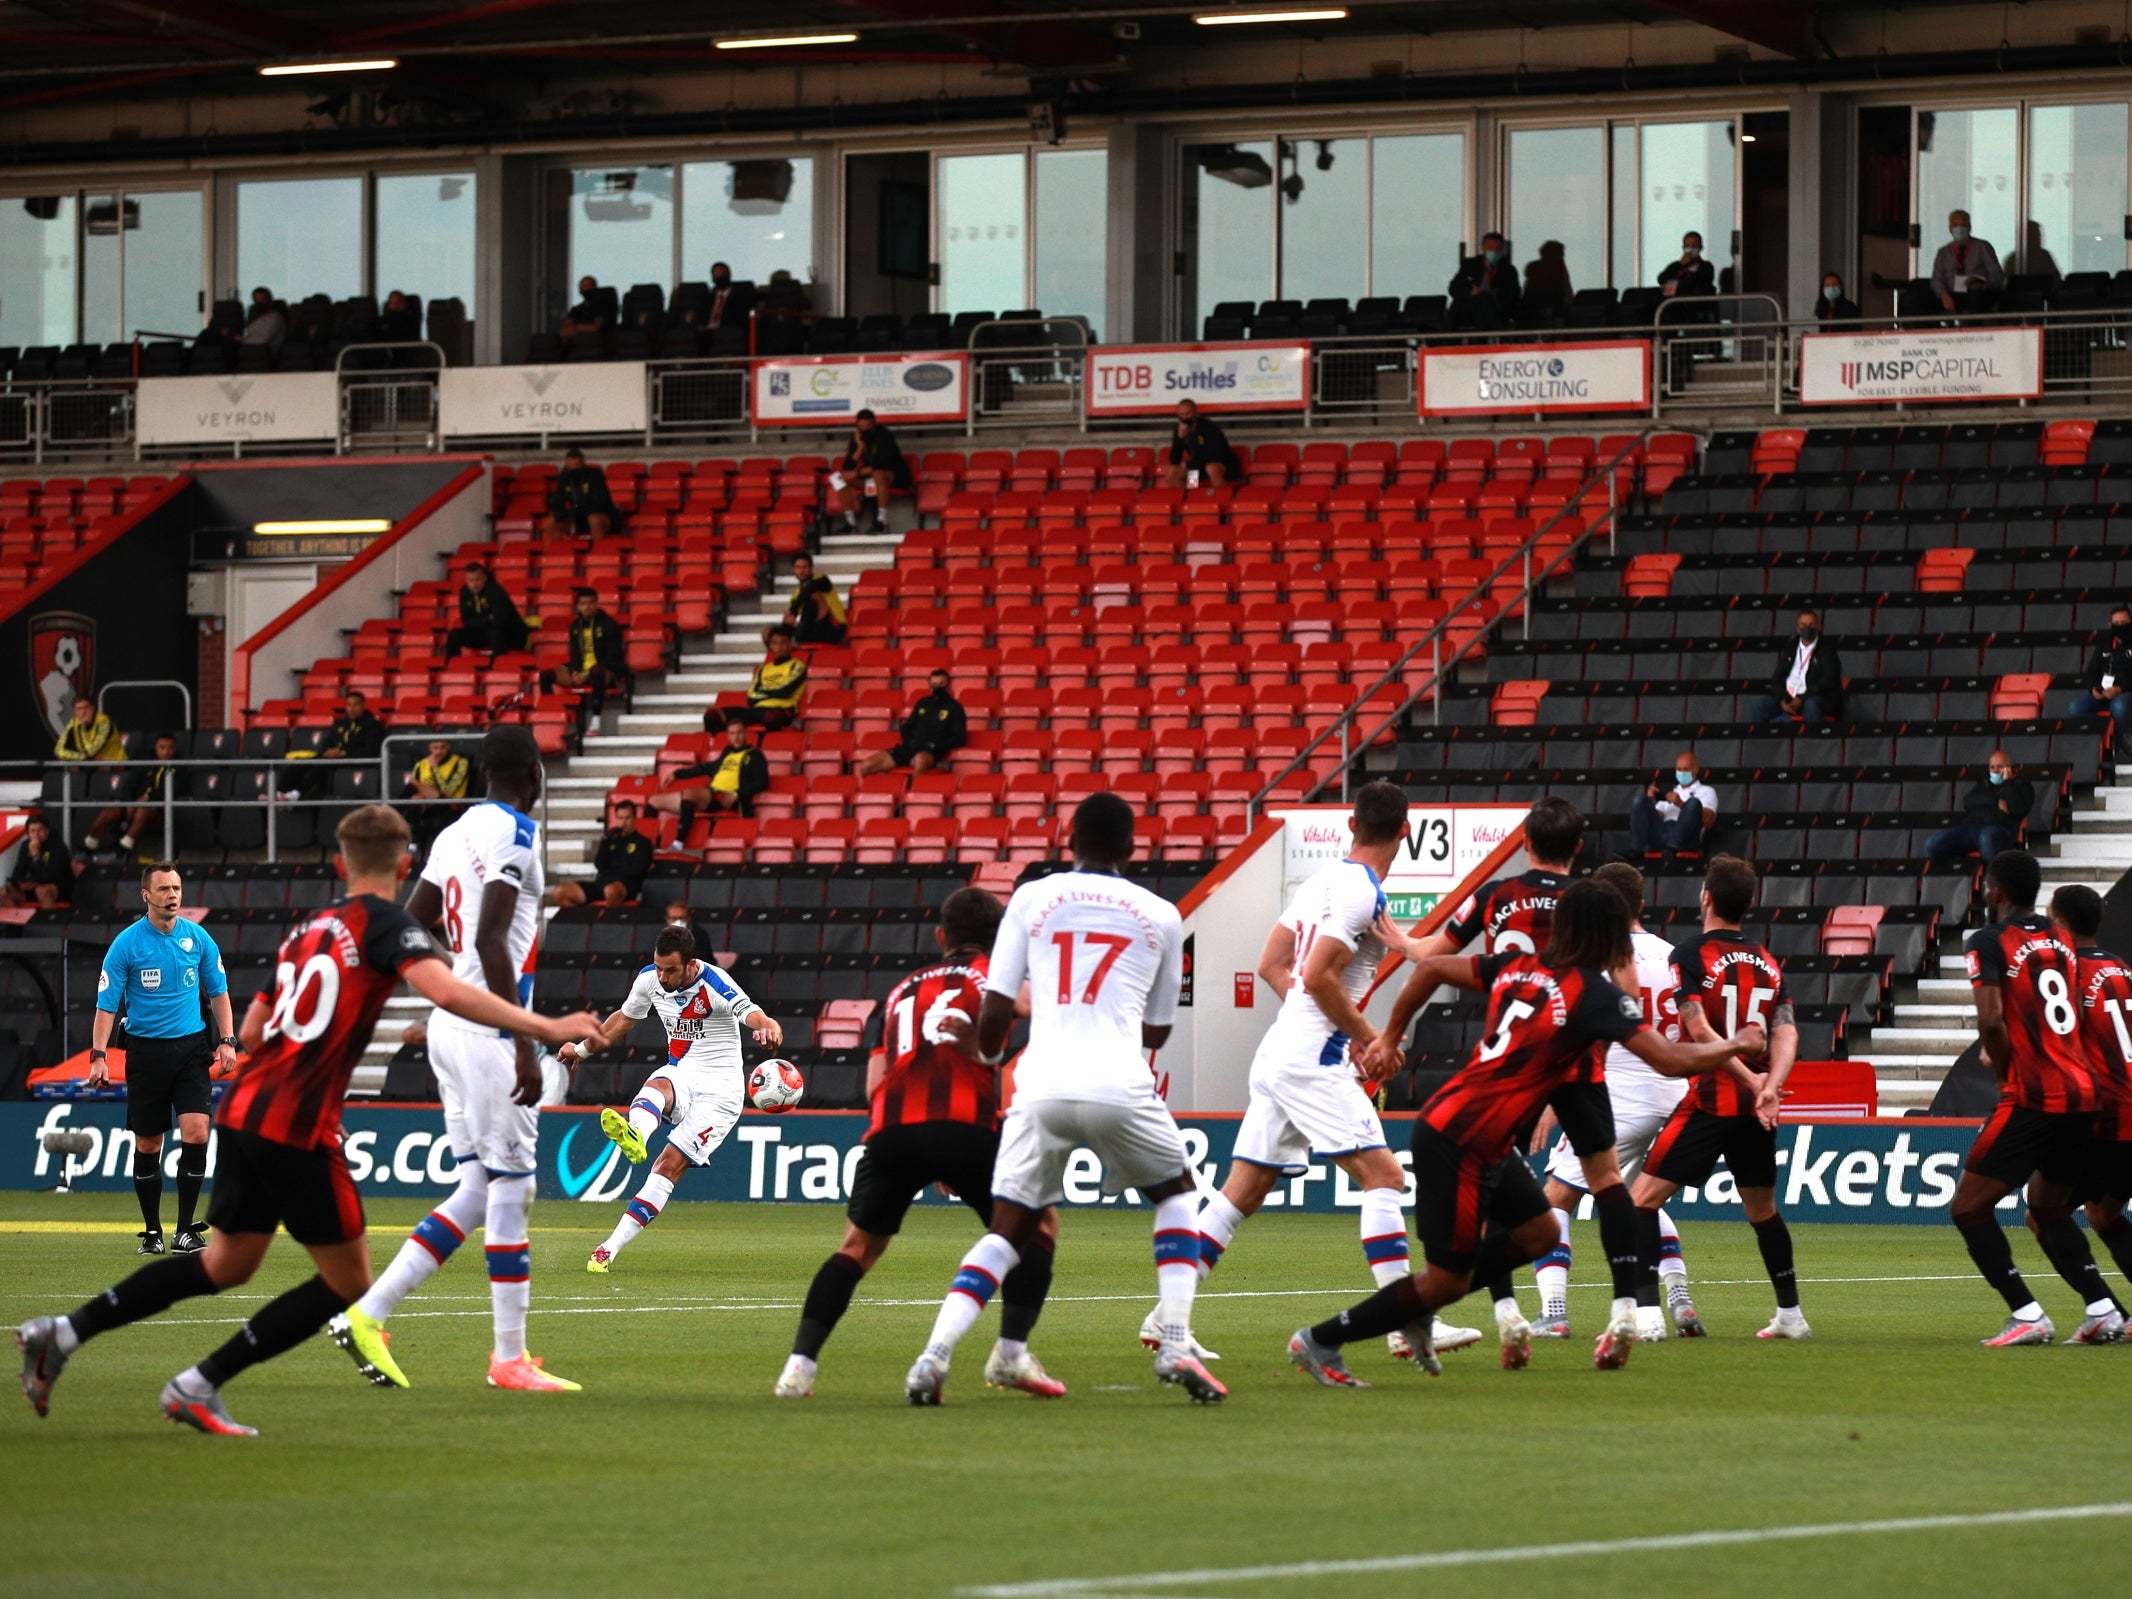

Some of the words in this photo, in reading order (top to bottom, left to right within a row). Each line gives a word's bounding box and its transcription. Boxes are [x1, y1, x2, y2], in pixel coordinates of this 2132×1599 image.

[1479, 359, 1546, 380] ENERGY
[1901, 349, 1922, 357] BANK
[1925, 348, 1938, 356] ON
[1099, 365, 1152, 391] TDB
[1165, 367, 1237, 390] Suttles
[1478, 379, 1588, 401] CONSULTING
[197, 411, 276, 428] VEYRON
[502, 402, 583, 418] VEYRON
[1303, 825, 1342, 846] Vitality
[1407, 818, 1450, 861] V3
[1473, 825, 1508, 844] Vitalit
[1292, 849, 1350, 859] STADIUM
[446, 875, 463, 954] 8
[1030, 895, 1067, 937] BLACK
[1072, 891, 1113, 904] LIVES
[1118, 899, 1158, 949] MATTER
[1488, 901, 1521, 937] BLACK
[142, 970, 159, 978] FIFA
[1051, 931, 1133, 1004] 17
[1702, 958, 1731, 989] BLACK
[1728, 951, 1755, 964] LIVES
[2006, 944, 2032, 978] BLACK
[262, 953, 340, 1042] 20
[2038, 968, 2076, 1035] 8
[2083, 971, 2105, 1007] BLACK
[894, 987, 973, 1055] 16
[1480, 999, 1535, 1062] 5
[1640, 986, 1682, 1043] 18
[1721, 984, 1775, 1050] 15
[698, 1126, 713, 1146] 4
